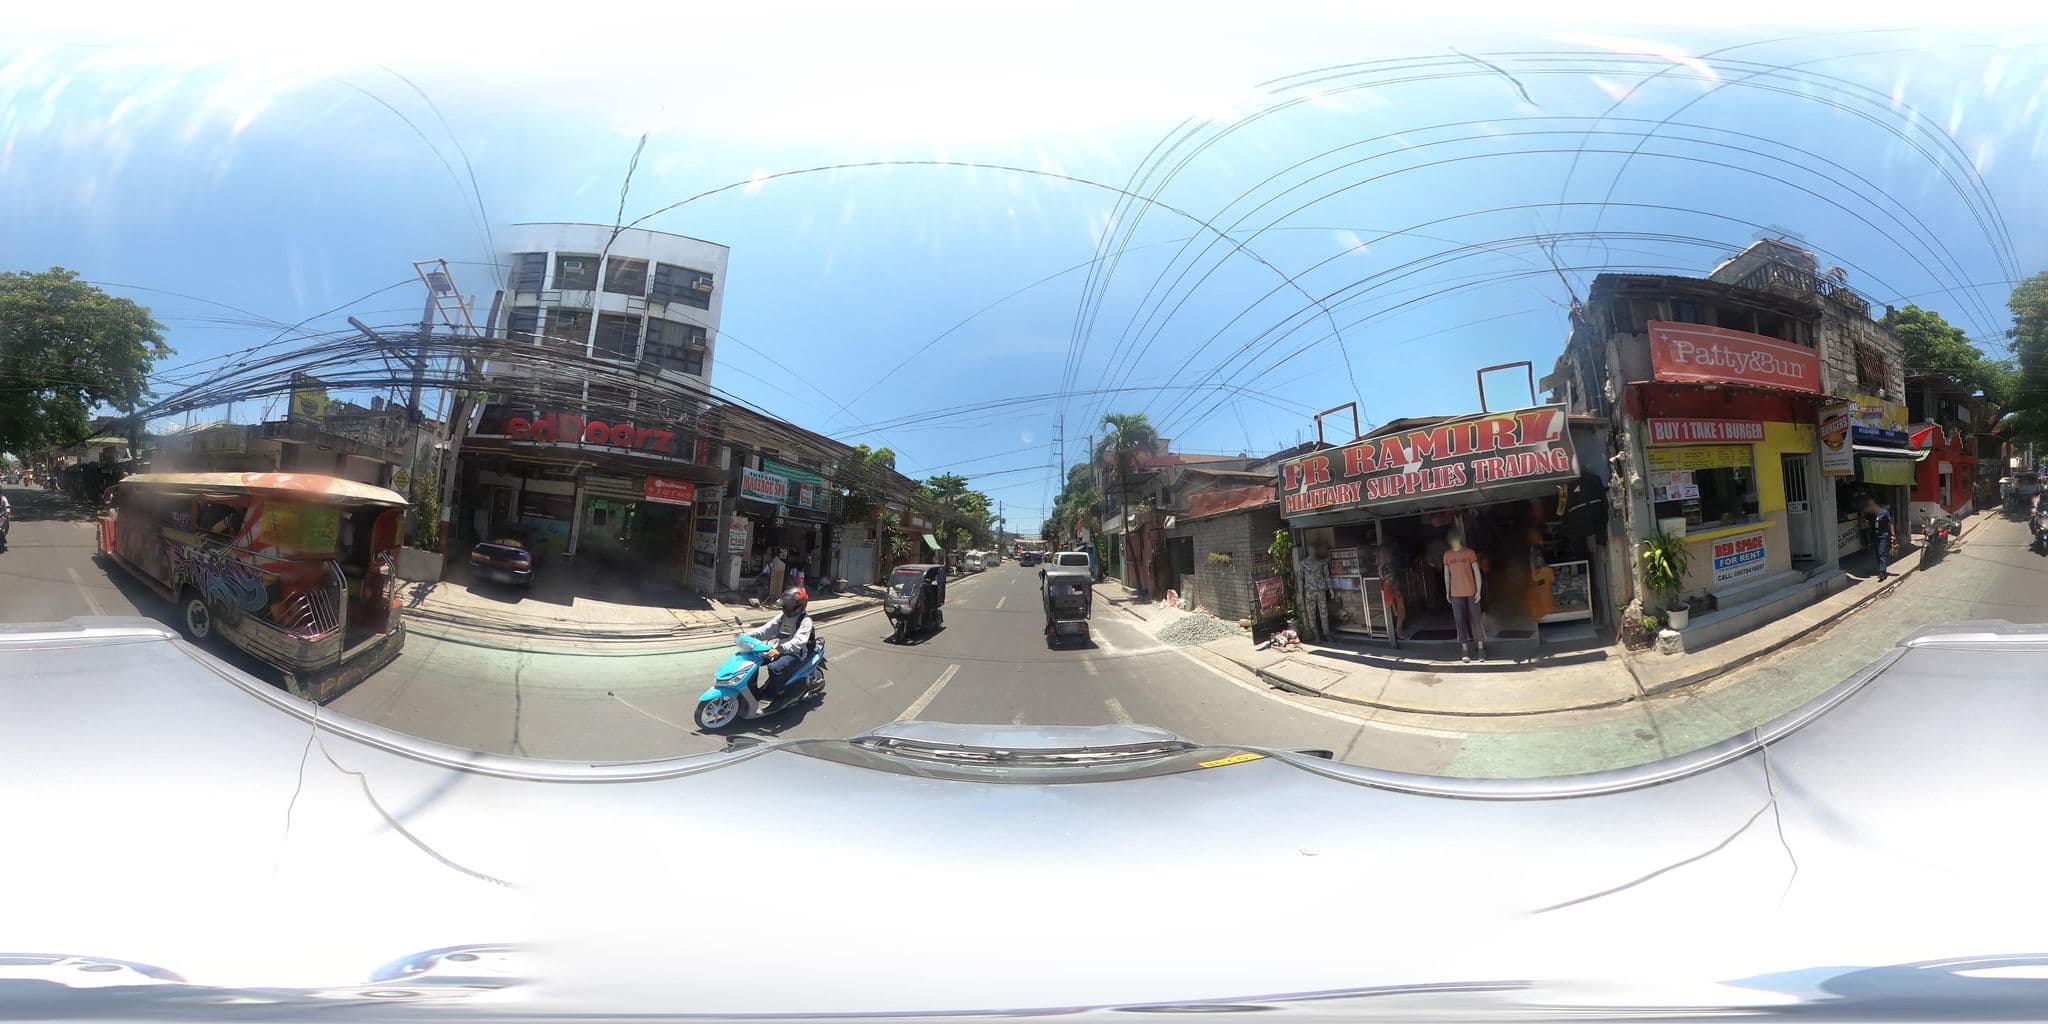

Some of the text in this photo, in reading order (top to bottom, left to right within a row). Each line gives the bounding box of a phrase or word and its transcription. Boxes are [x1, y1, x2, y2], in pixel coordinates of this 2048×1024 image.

[1655, 422, 1763, 440] BUY 1 TAKE 1 BURGER
[1284, 455, 1330, 490] FR
[743, 475, 774, 495] MASSAGE
[1285, 480, 1362, 514] MILITARY
[1367, 462, 1467, 500] SUPPLIES
[1735, 535, 1763, 553] SPACE
[1720, 556, 1738, 568] FOR
[1739, 550, 1761, 562] RENT
